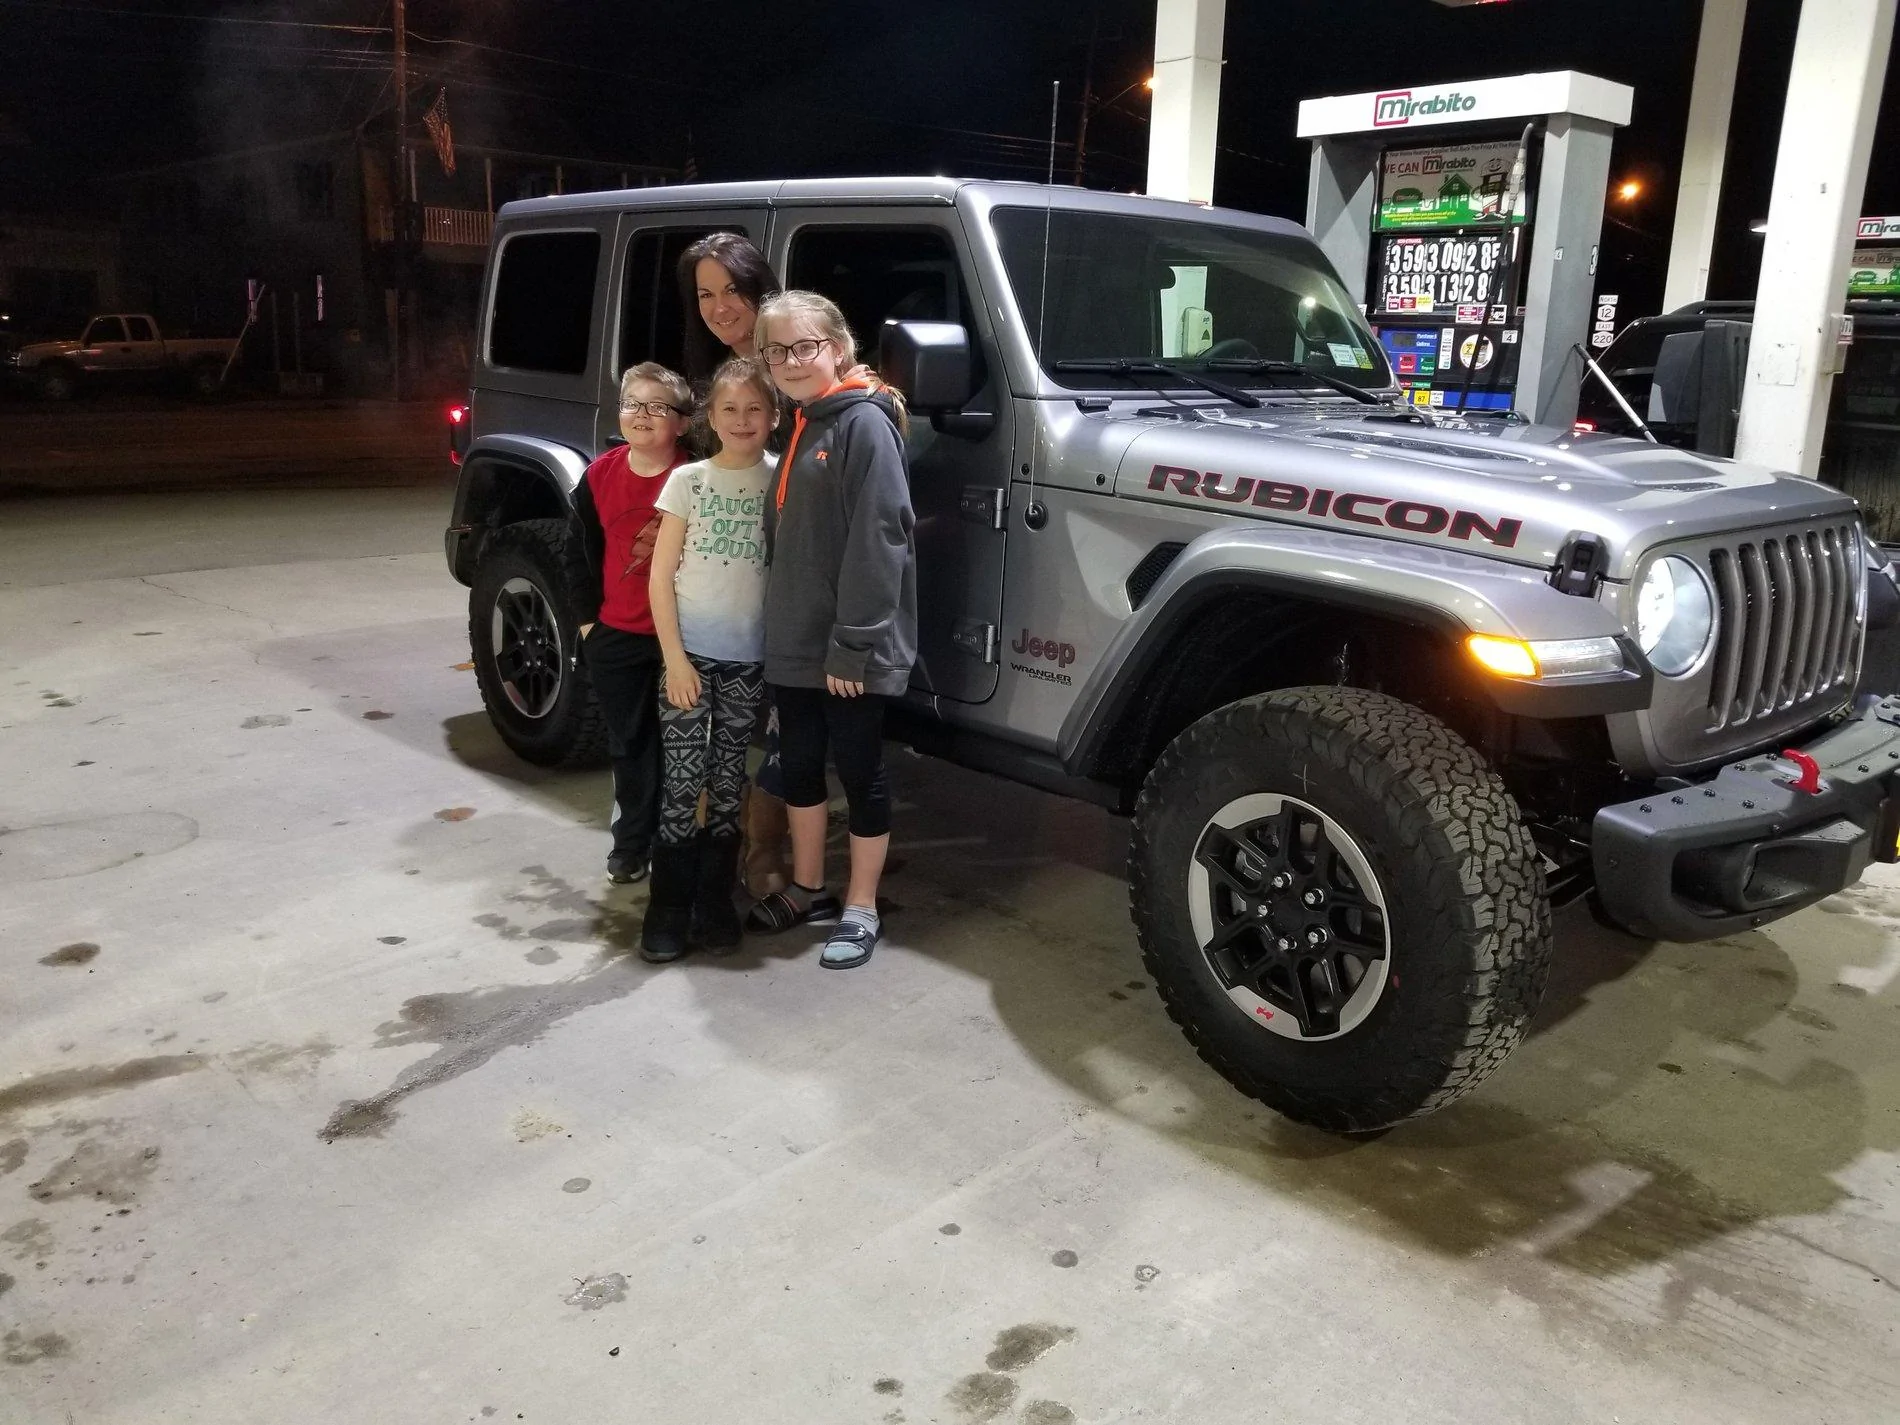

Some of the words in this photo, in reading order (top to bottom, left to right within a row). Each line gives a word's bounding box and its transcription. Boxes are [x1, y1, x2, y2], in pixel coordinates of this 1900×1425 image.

[1379, 93, 1476, 119] Mirabito
[1398, 162, 1419, 173] CAN
[1424, 156, 1477, 171] Mirabito
[1601, 308, 1611, 318] 12
[1506, 334, 1512, 342] 4
[1594, 335, 1612, 343] 220
[1417, 395, 1426, 403] 87
[1147, 464, 1523, 548] RUBICON
[711, 518, 759, 540] OUT
[1011, 628, 1076, 669] Jeep
[1009, 662, 1072, 683] WRANGLER
[1028, 673, 1072, 687] UNLIMITED
